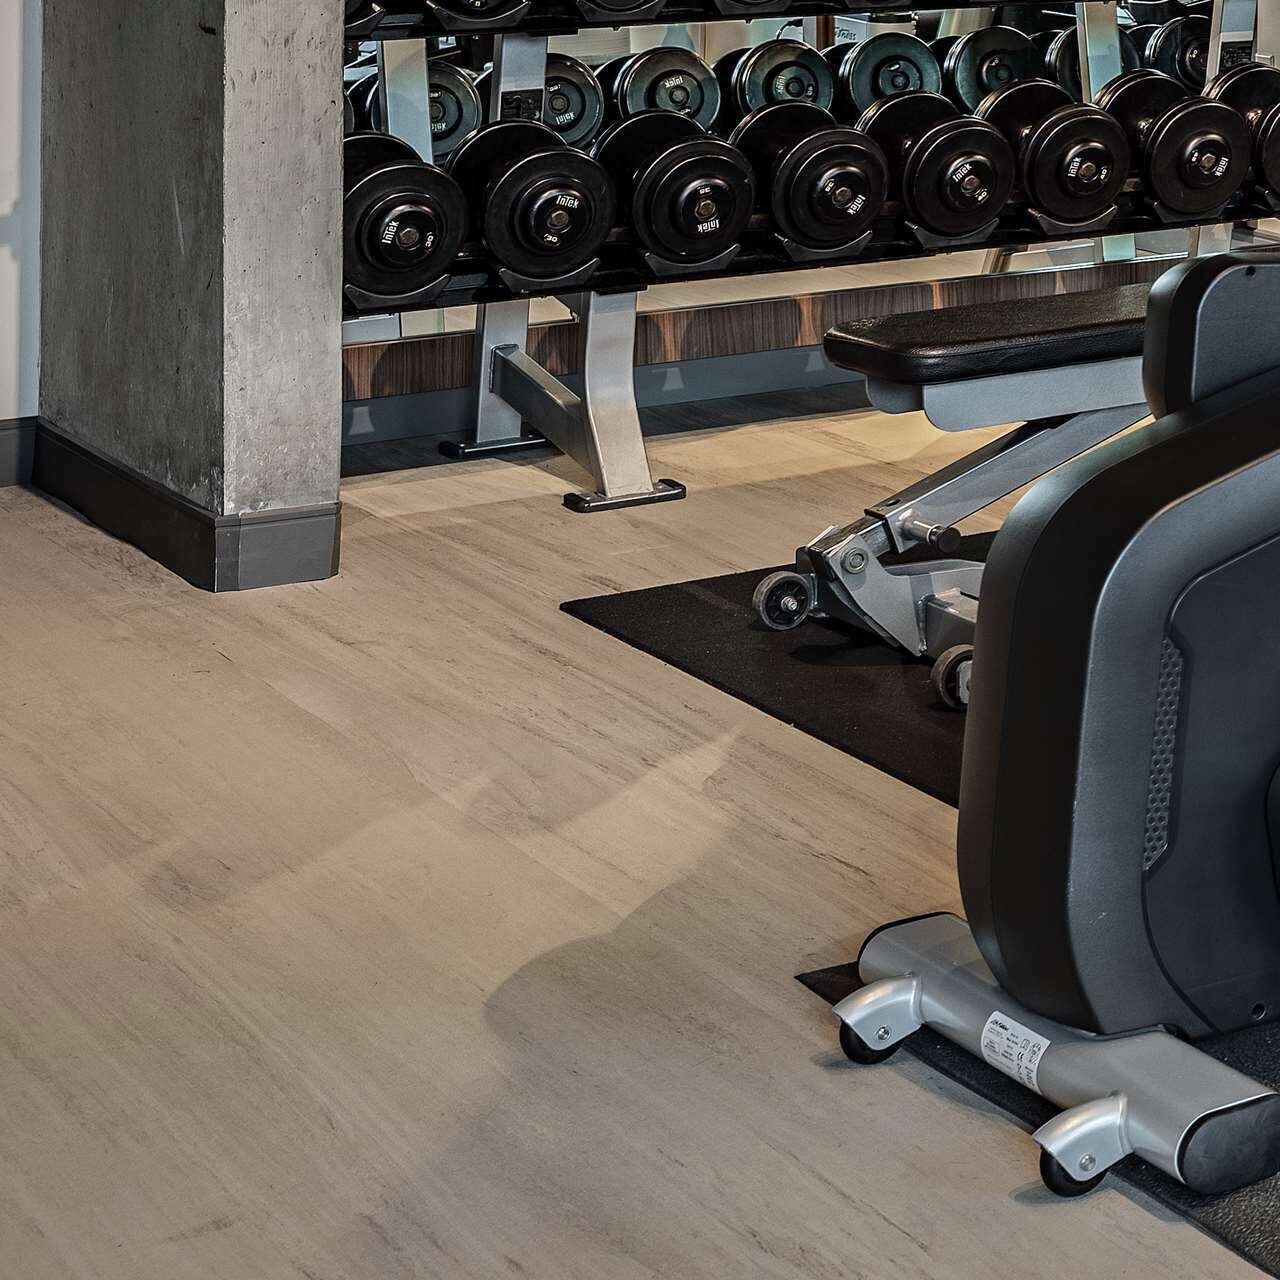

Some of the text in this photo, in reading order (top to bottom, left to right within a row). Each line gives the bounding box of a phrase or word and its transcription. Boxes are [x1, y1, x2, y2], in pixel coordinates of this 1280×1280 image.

[952, 162, 973, 183] InTek
[1067, 157, 1083, 178] InTek
[556, 194, 579, 209] InTek
[847, 194, 867, 216] InTek
[382, 220, 400, 245] InTek
[697, 219, 720, 234] InTek
[546, 234, 558, 243] 30
